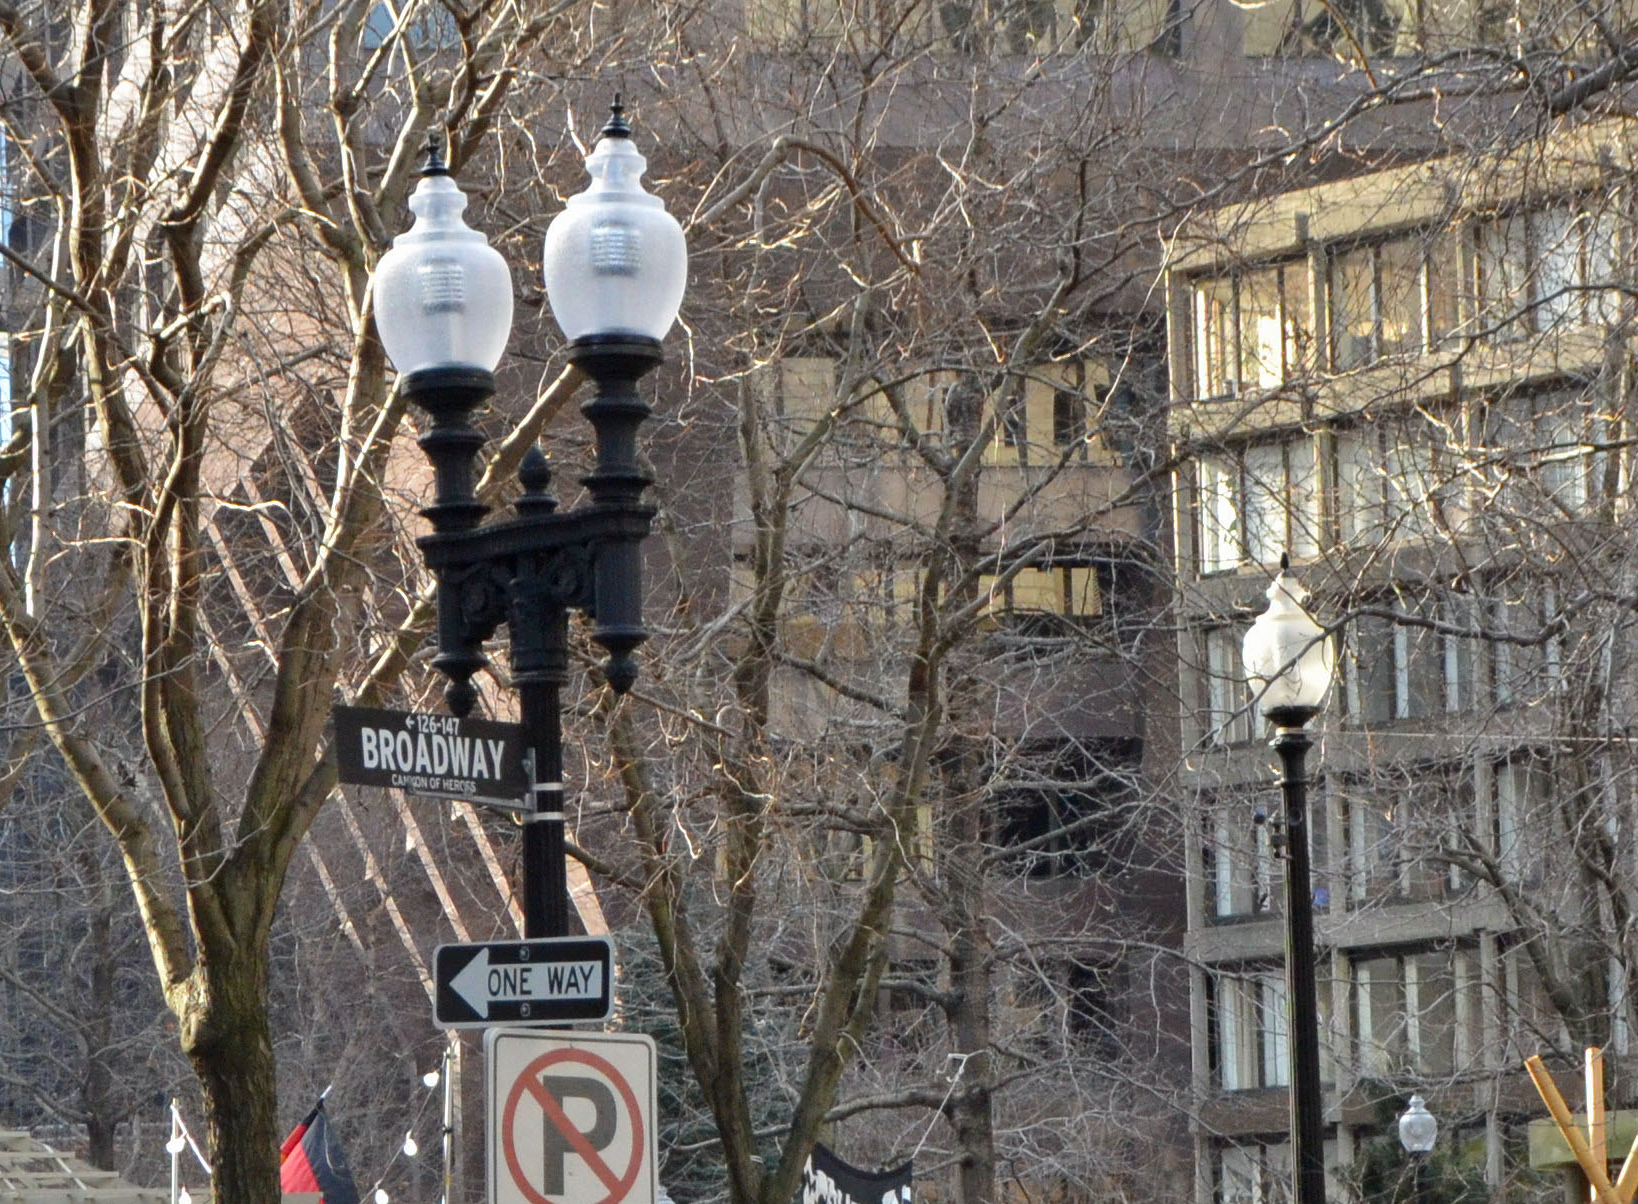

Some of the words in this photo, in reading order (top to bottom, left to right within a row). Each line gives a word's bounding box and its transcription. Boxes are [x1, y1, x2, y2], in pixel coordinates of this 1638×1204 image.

[417, 715, 460, 735] 126-147
[361, 727, 505, 780] BROADWAY
[430, 778, 441, 789] OF
[443, 780, 477, 793] HEROES
[488, 967, 532, 997] ONE
[548, 965, 594, 994] WAY
